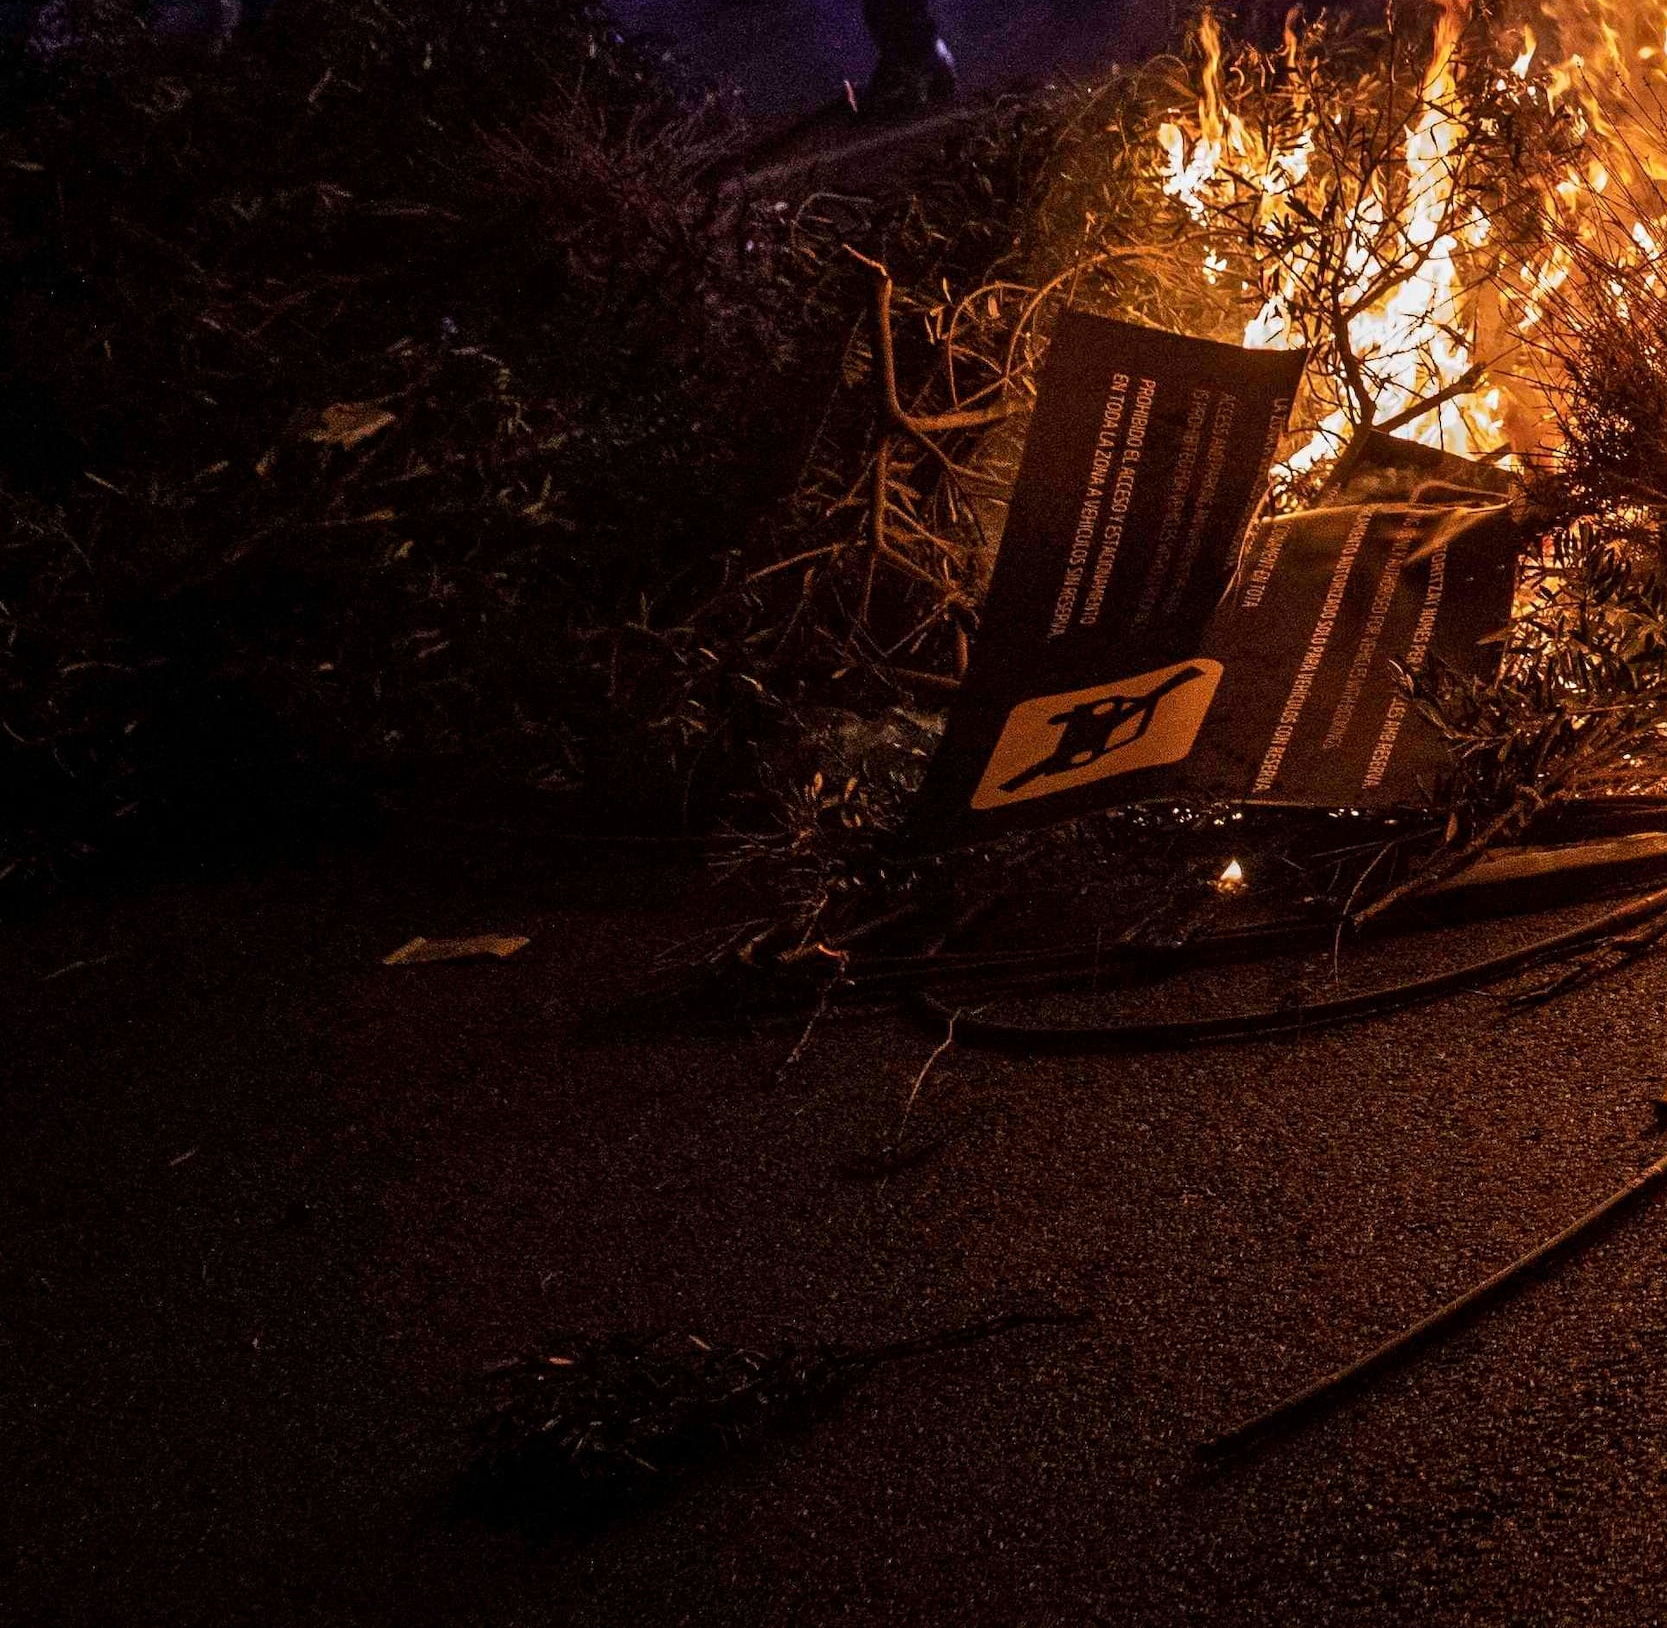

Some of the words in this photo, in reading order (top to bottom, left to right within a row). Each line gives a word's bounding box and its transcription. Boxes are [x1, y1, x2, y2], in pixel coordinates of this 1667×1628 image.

[1109, 372, 1131, 392] EN
[1100, 394, 1125, 429] TODA
[1124, 378, 1157, 447] PROHIBIDO
[1095, 430, 1116, 448] LA
[1086, 449, 1112, 486] ZONA
[1120, 448, 1139, 465] EL
[1083, 487, 1102, 498] A
[1109, 465, 1135, 513] ACCESO
[1062, 565, 1083, 587] SIN
[1315, 555, 1358, 619] AUTORIZADO
[1308, 620, 1334, 645] SOLO
[1298, 645, 1324, 672] PARA
[1269, 725, 1293, 745] CON
